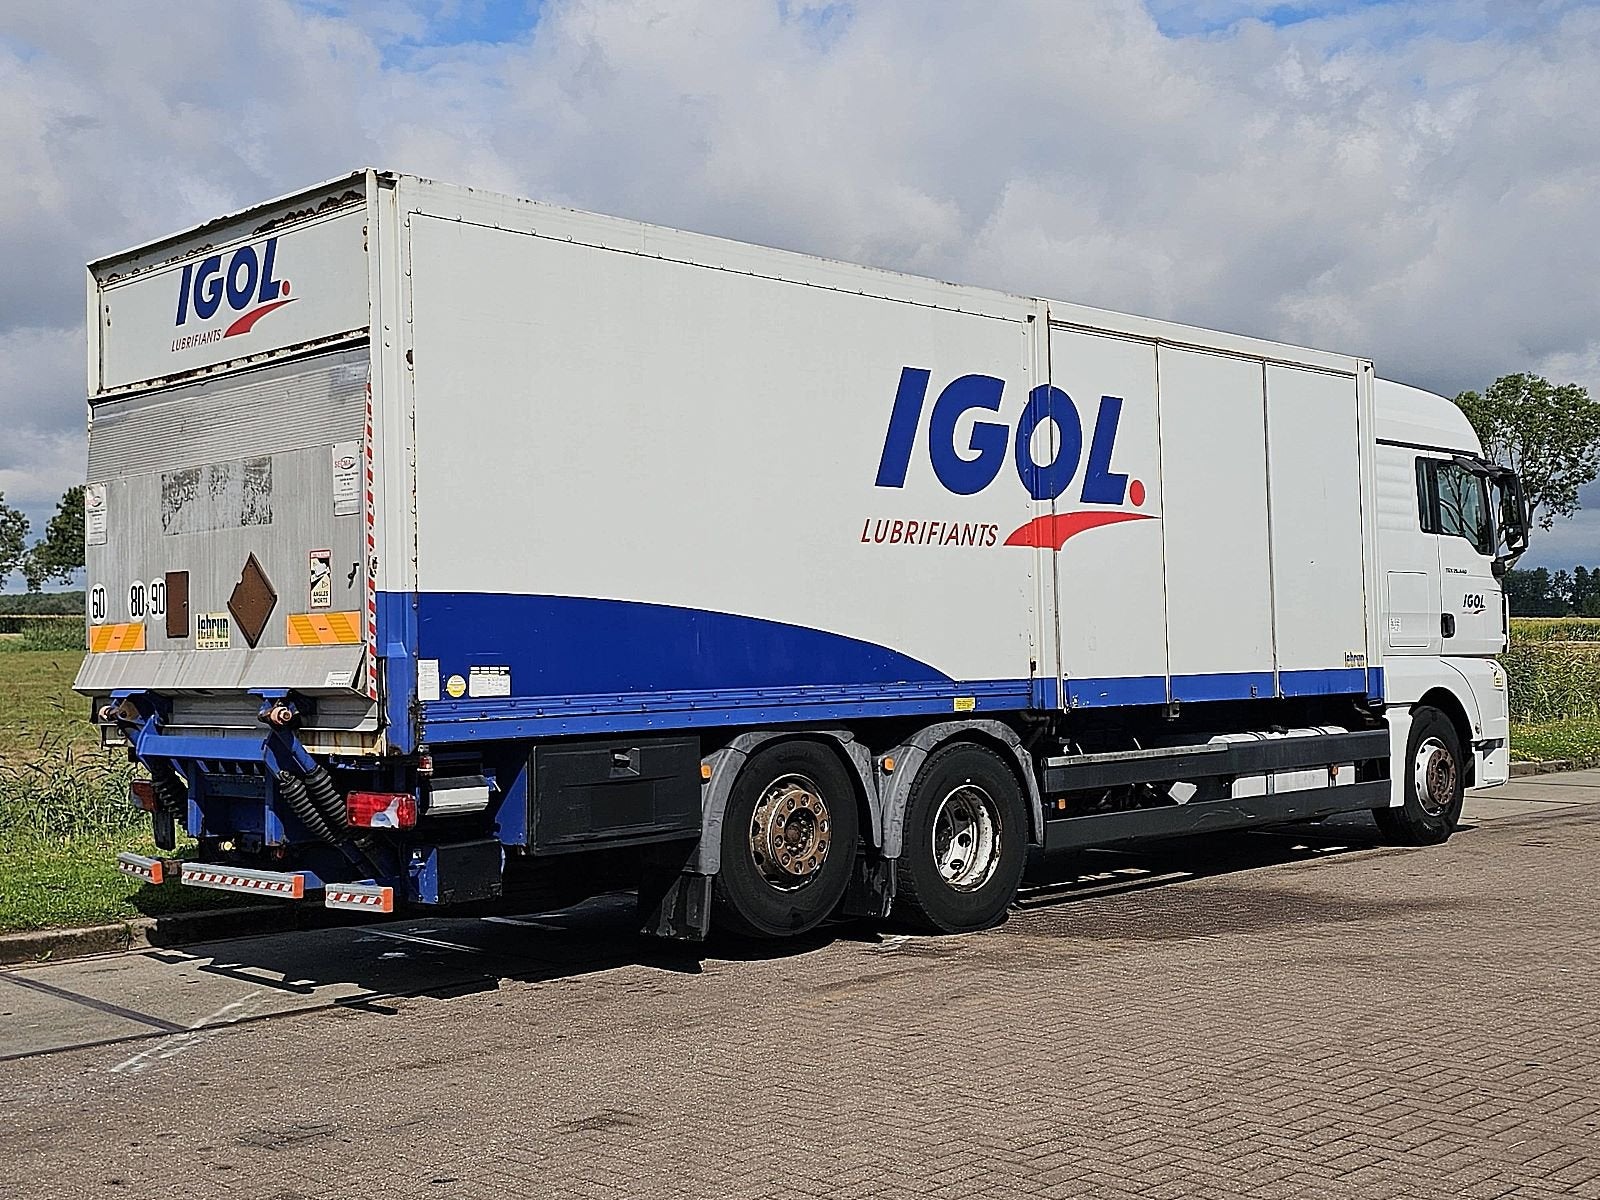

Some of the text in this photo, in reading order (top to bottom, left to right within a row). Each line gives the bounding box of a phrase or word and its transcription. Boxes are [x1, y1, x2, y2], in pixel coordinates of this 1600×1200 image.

[171, 329, 222, 352] LUBRIFIANTS
[861, 518, 999, 547] LUBRIFIANTS
[92, 587, 105, 619] 60
[130, 585, 144, 617] 80
[151, 582, 165, 615] 90
[197, 614, 229, 640] lebrun
